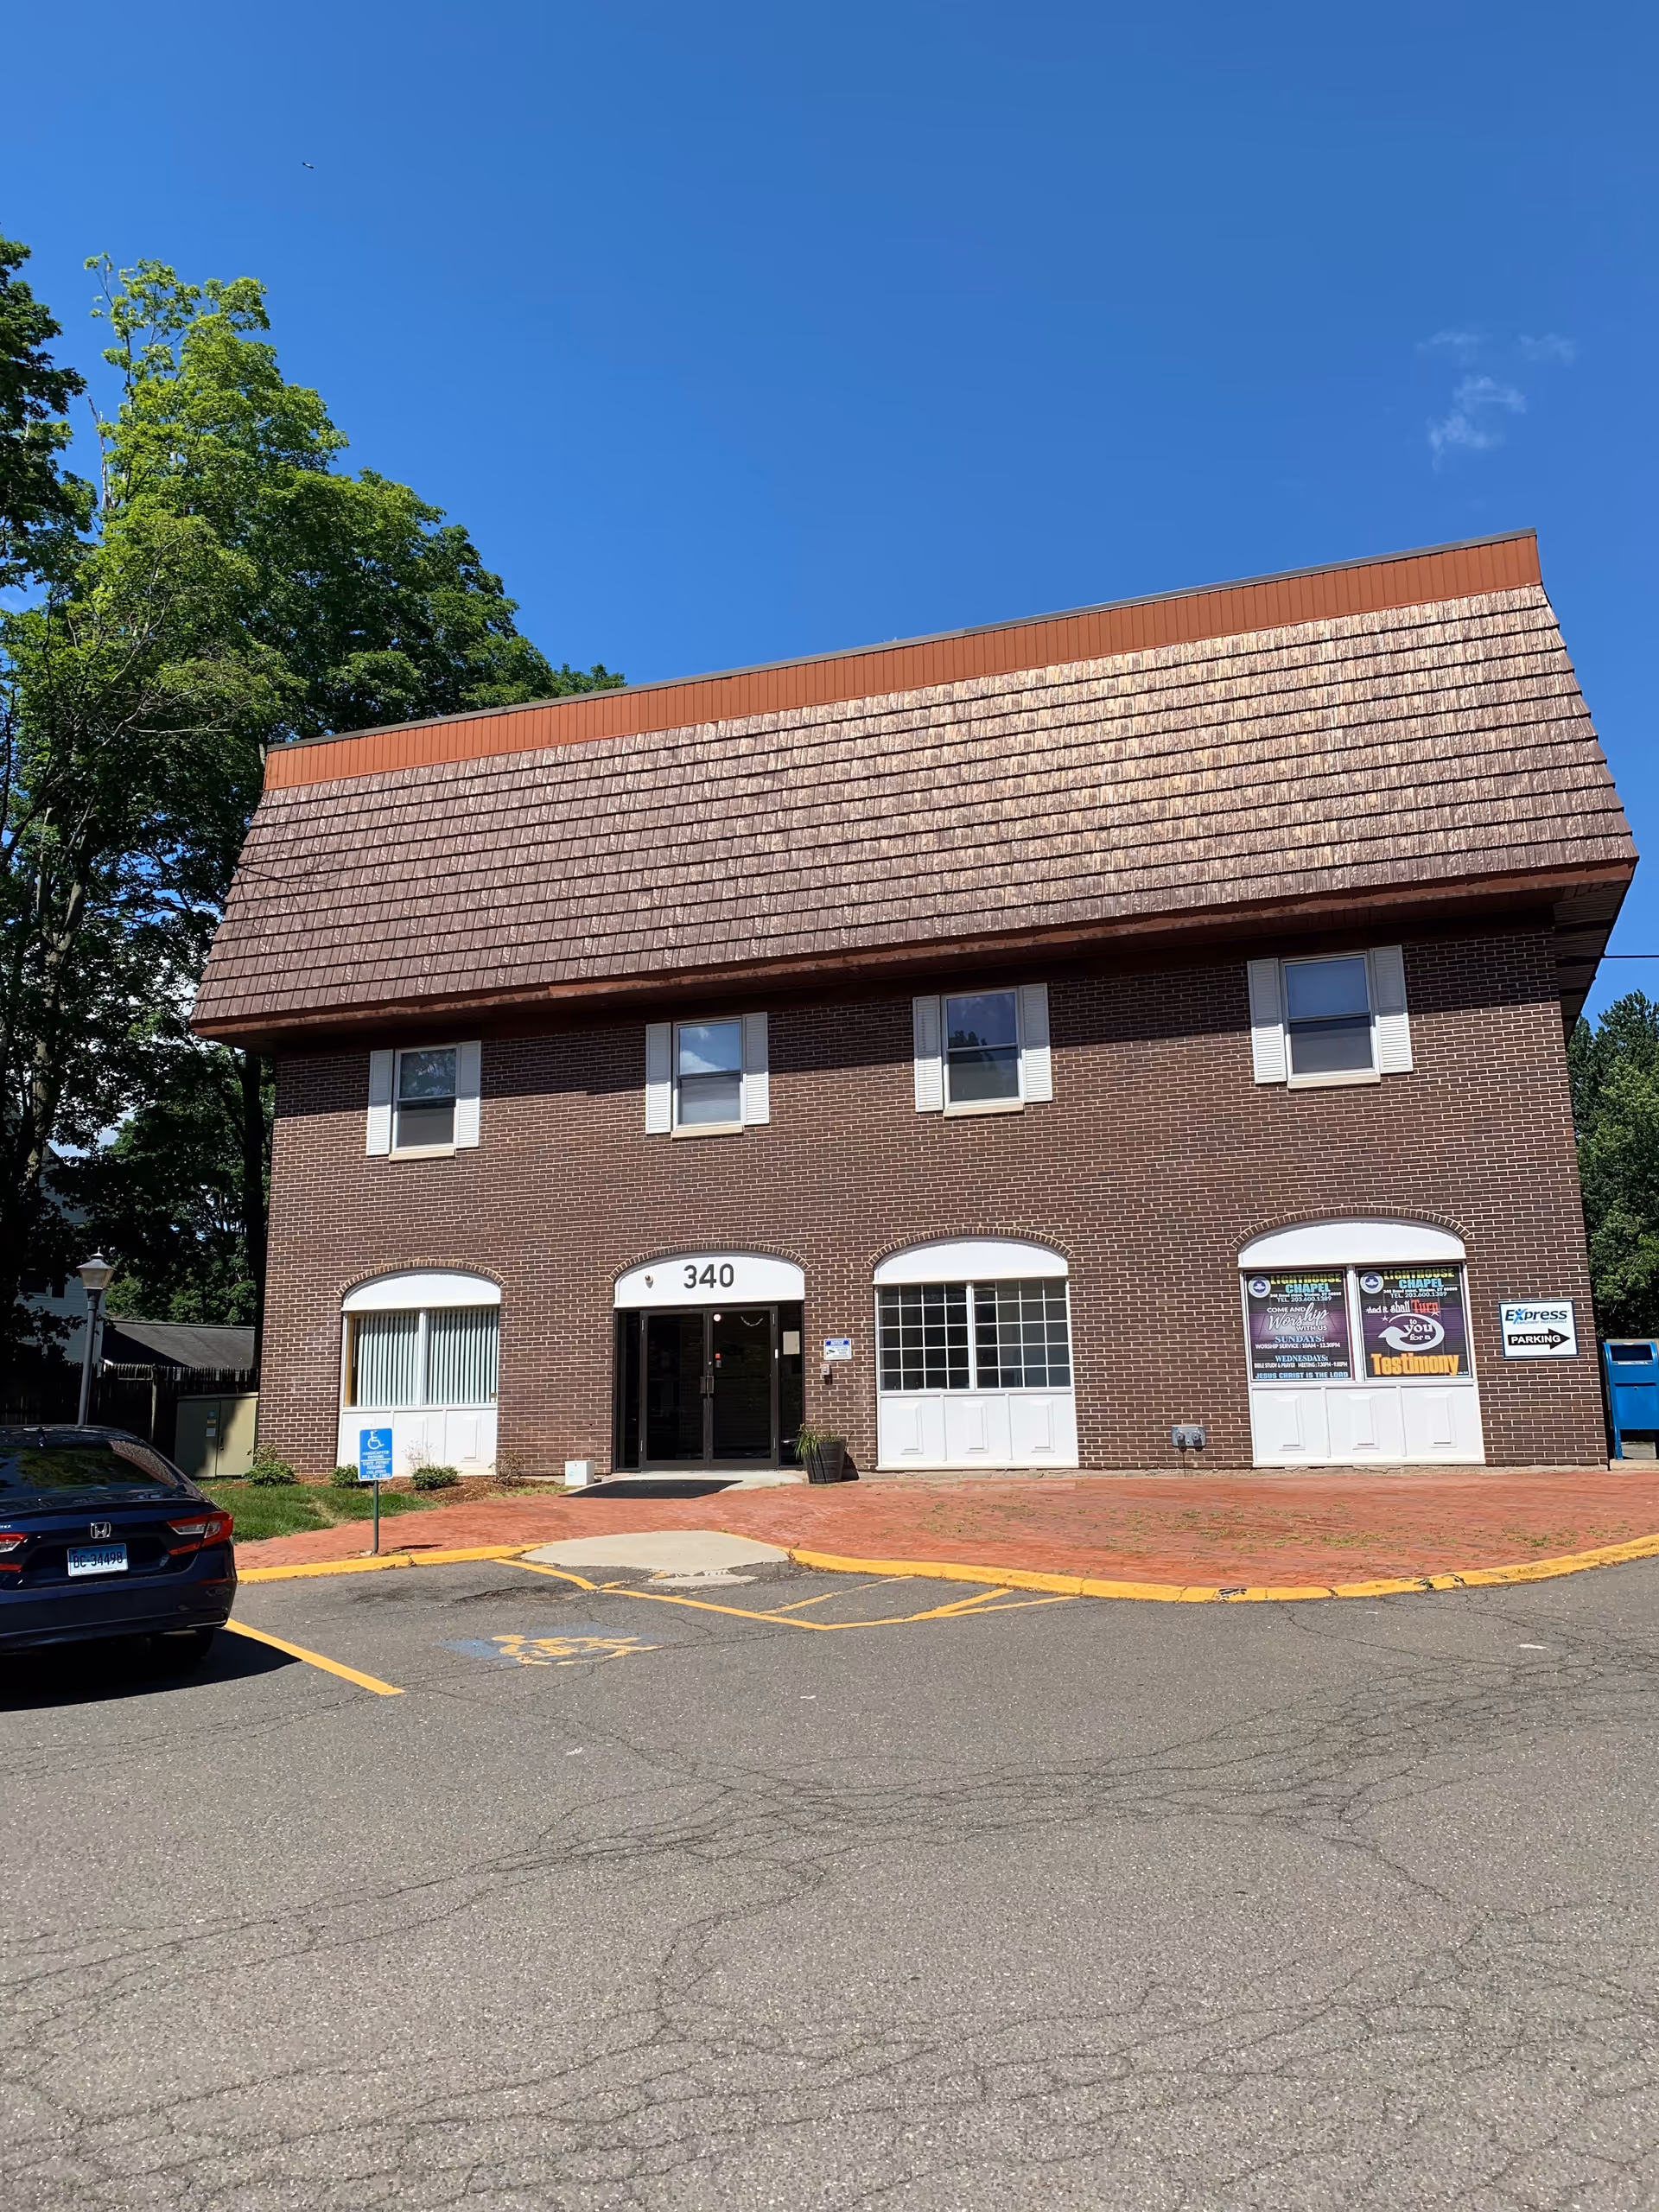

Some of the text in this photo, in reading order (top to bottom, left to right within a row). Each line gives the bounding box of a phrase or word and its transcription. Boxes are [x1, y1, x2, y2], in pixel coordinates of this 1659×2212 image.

[683, 1263, 734, 1288] 340
[1286, 1283, 1331, 1294] CHAPEL
[1399, 1278, 1444, 1289] CHAPEL
[1390, 1300, 1410, 1313] shall
[1411, 1300, 1439, 1313] Turn
[1268, 1302, 1329, 1330] Worship
[1403, 1324, 1433, 1334] you
[1511, 1335, 1560, 1344] PARKING
[1370, 1352, 1459, 1376] Testimony
